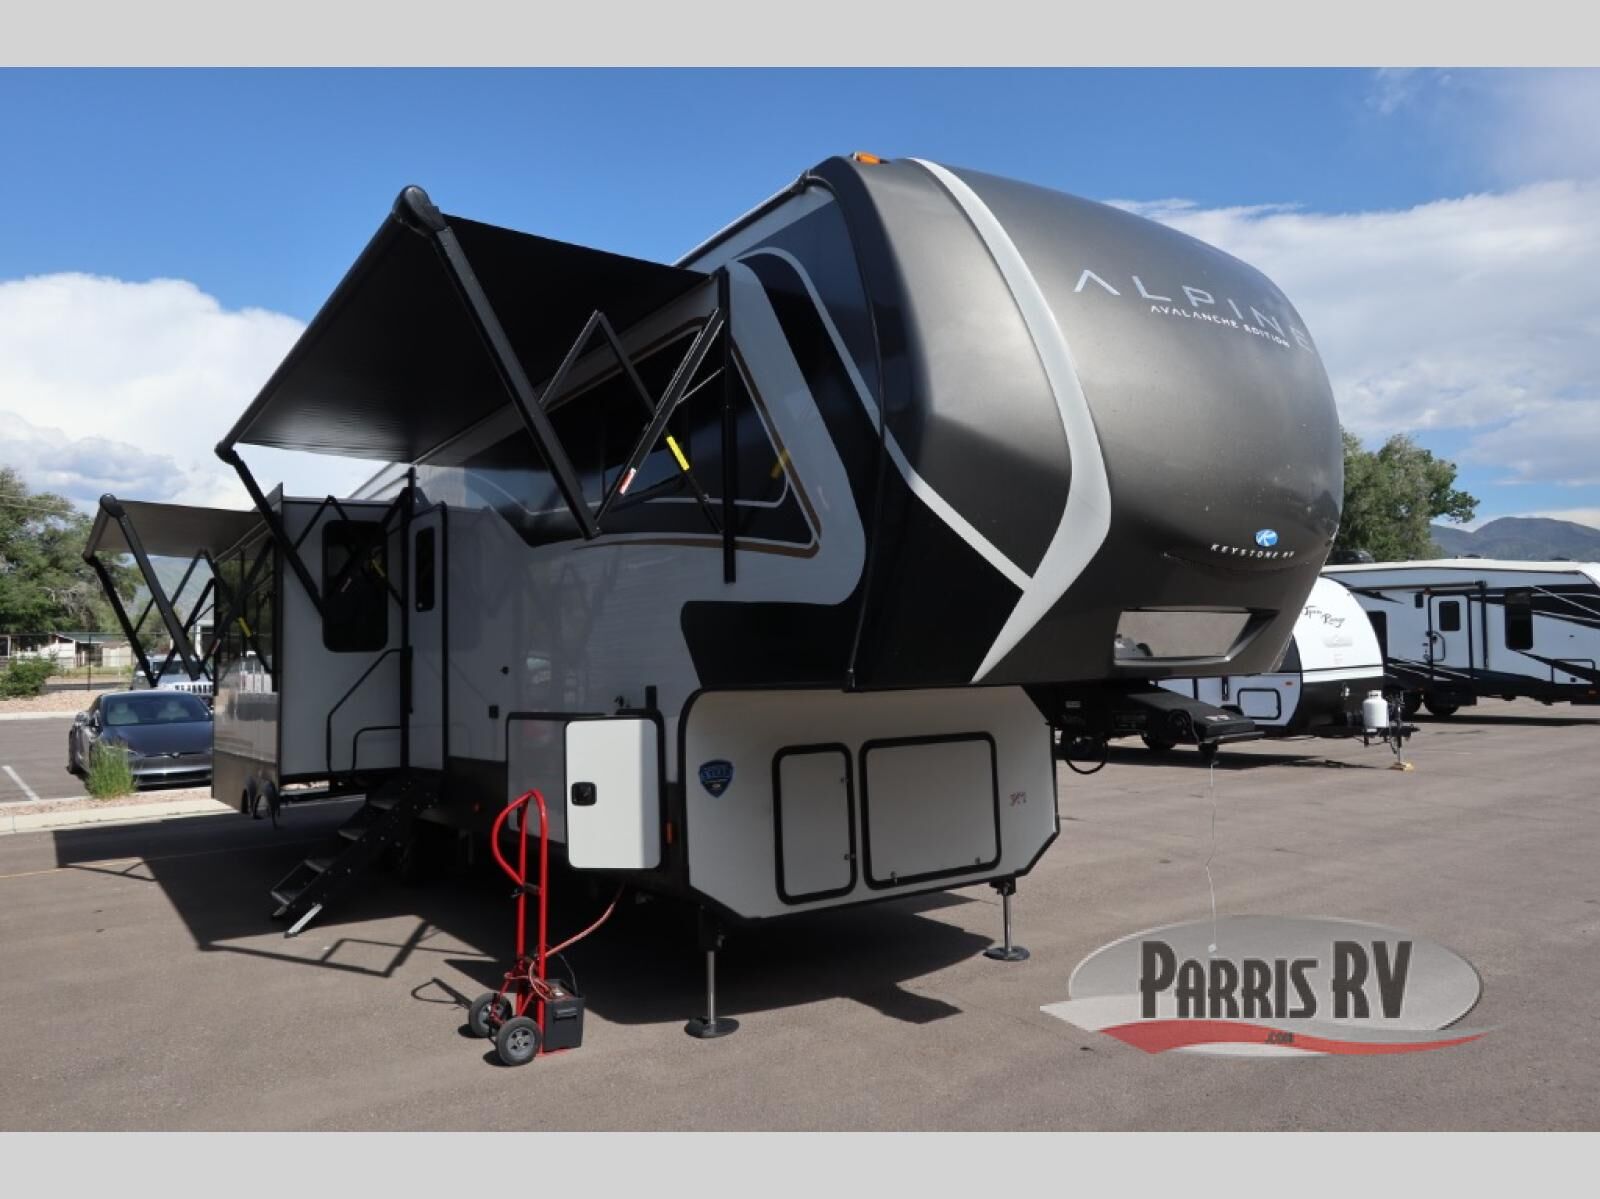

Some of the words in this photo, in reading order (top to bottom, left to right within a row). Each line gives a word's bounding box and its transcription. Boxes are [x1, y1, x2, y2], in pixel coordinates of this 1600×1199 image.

[1074, 269, 1313, 353] ALPINE
[1150, 304, 1239, 329] AVALANCHE
[1210, 543, 1278, 559] KEYSTONE
